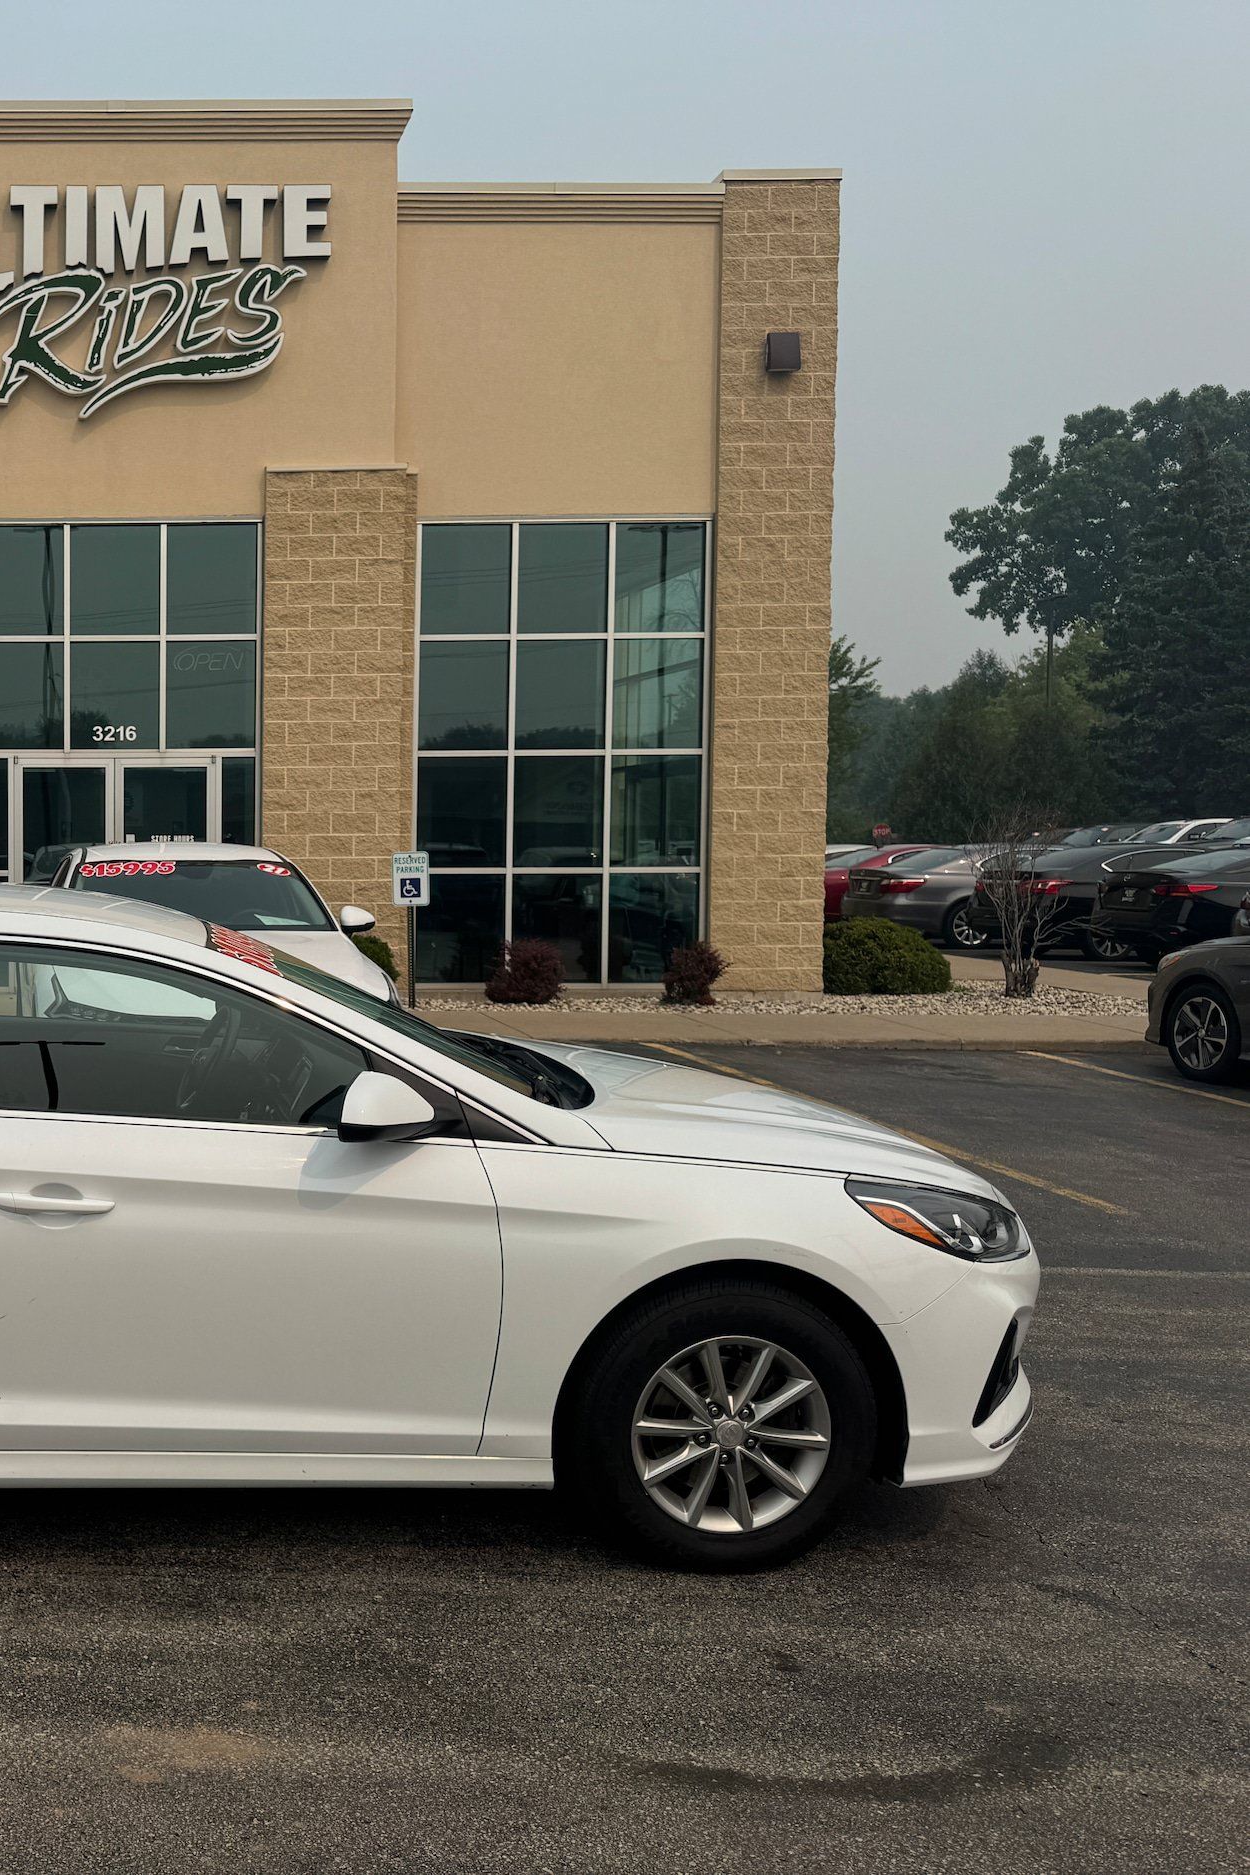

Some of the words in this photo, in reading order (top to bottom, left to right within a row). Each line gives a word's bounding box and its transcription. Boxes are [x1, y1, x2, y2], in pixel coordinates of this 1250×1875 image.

[176, 652, 244, 671] OPEN
[92, 725, 137, 741] 3216
[79, 861, 176, 877] $15995
